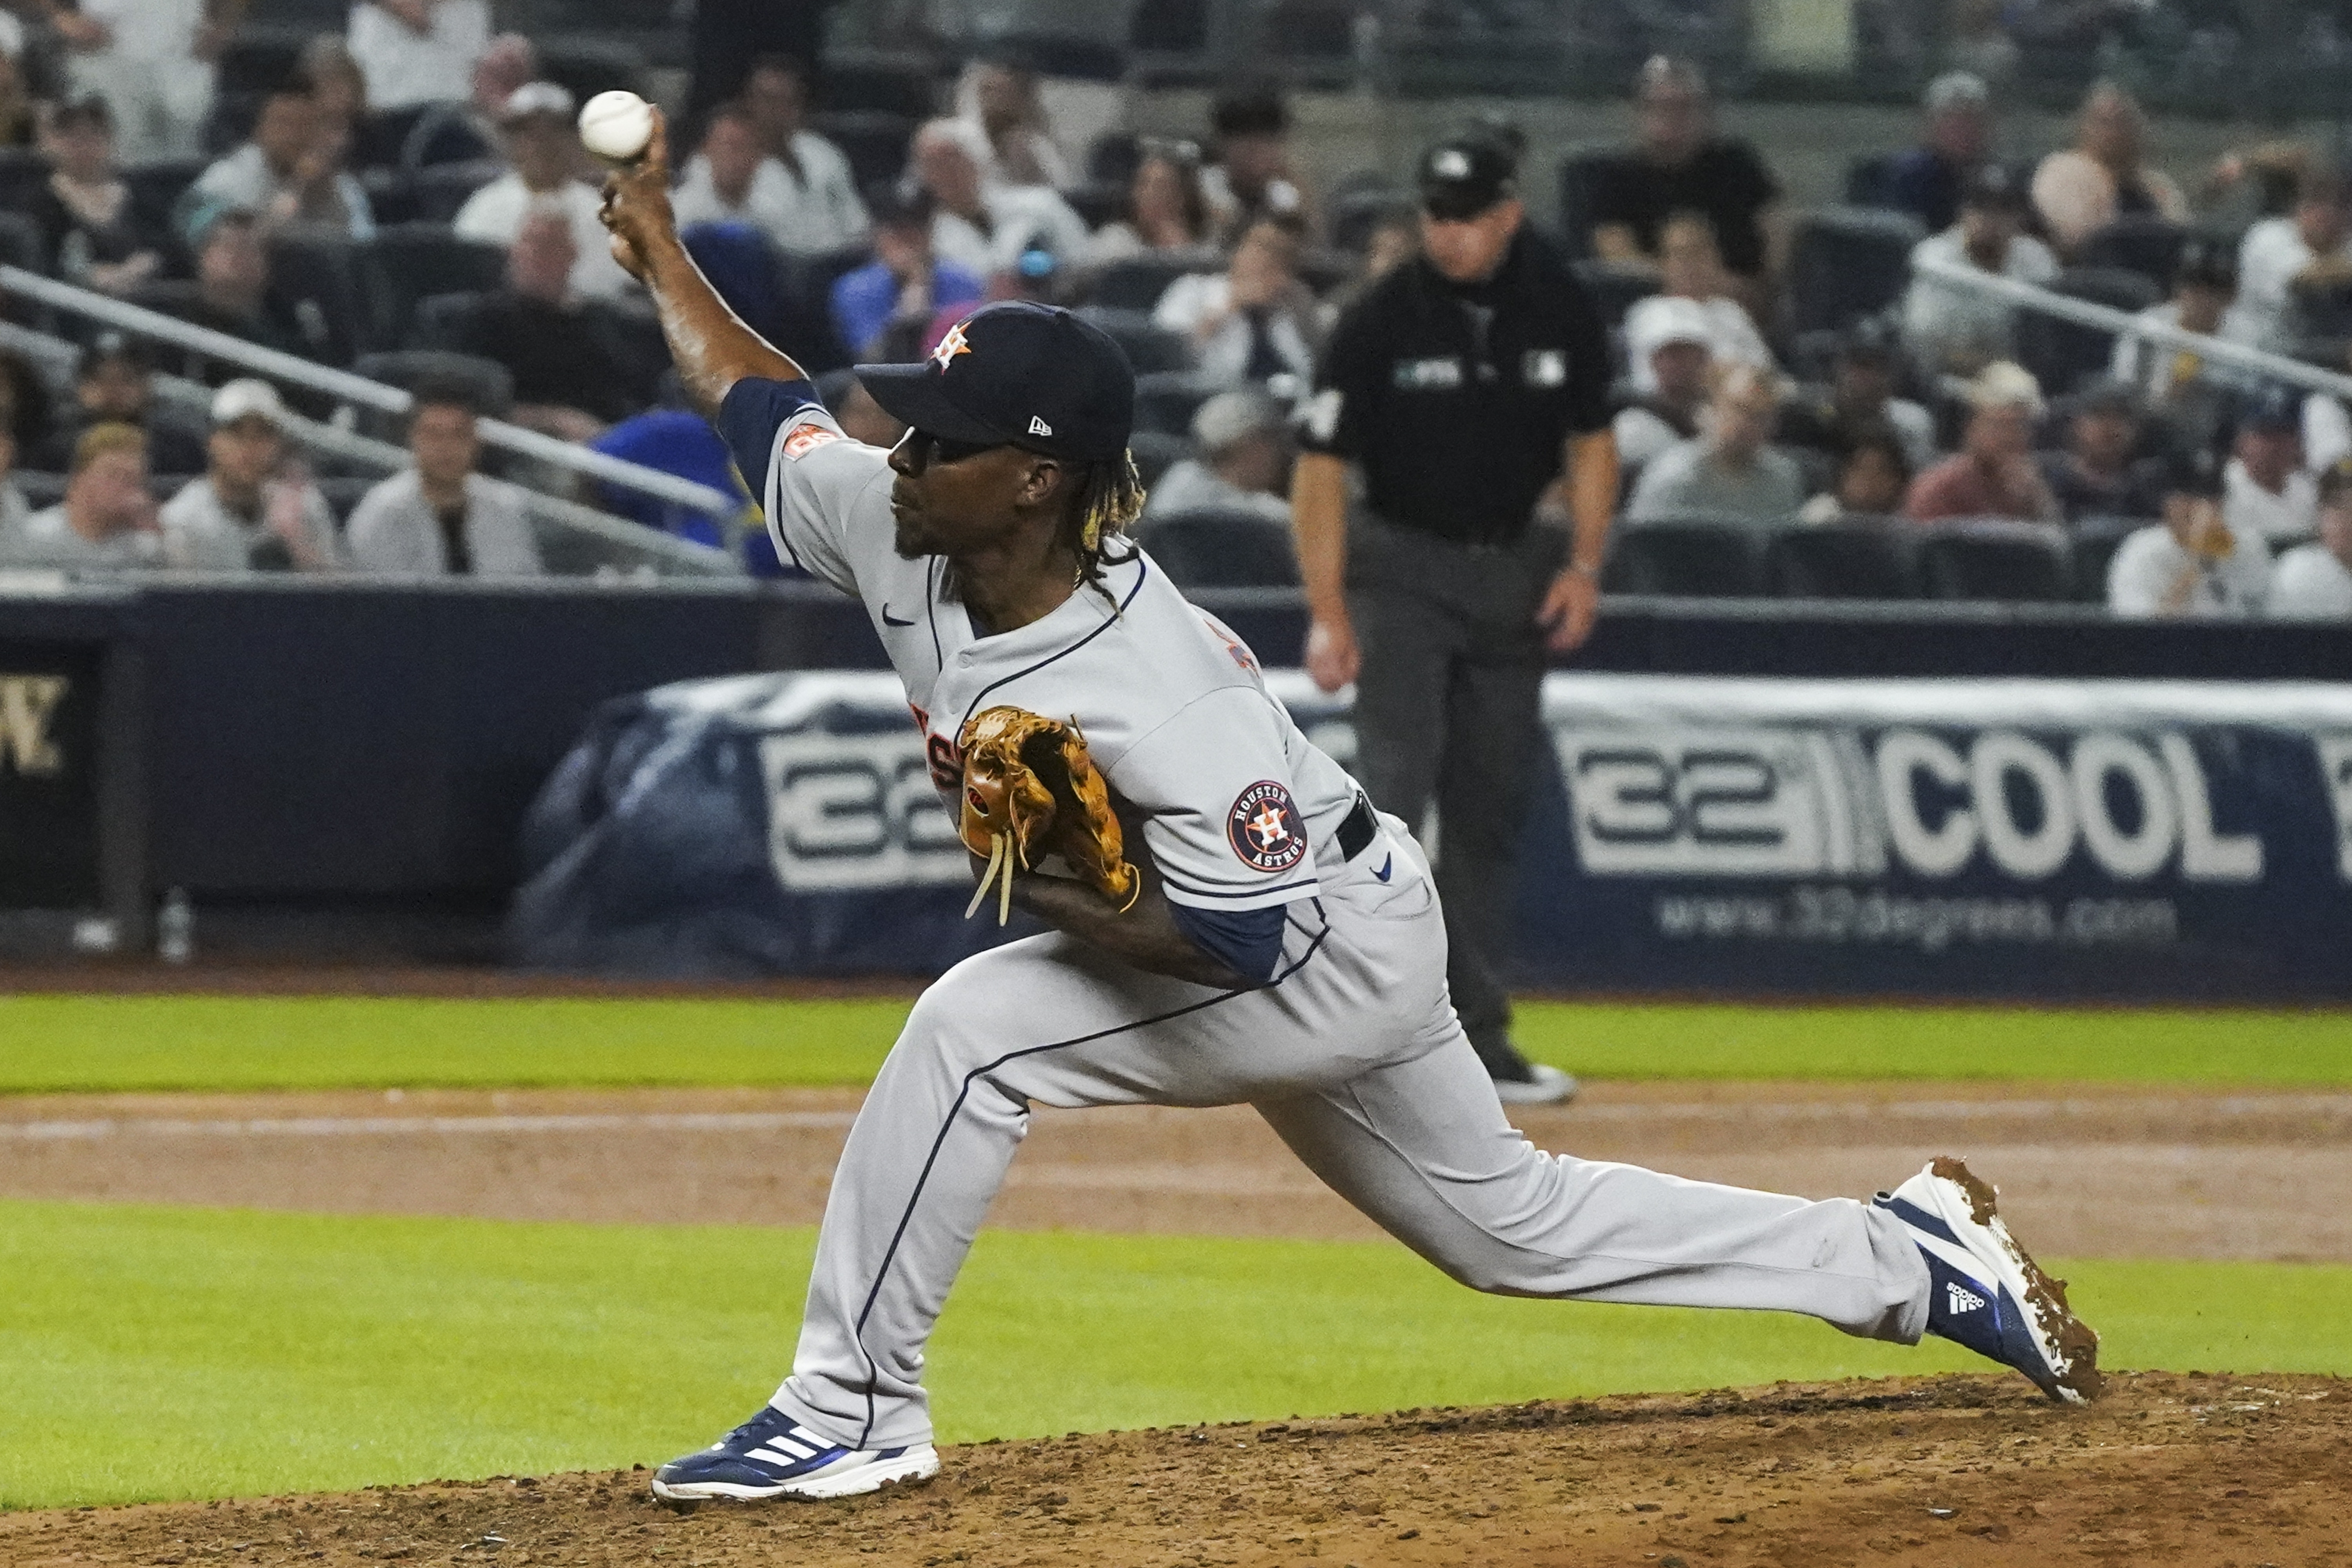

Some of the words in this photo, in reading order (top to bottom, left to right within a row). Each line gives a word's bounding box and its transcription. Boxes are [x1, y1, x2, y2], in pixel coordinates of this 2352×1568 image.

[1234, 786, 1288, 821] HOUSTON
[1574, 743, 1789, 849] 32
[1877, 728, 2265, 883] COOL
[1252, 836, 1303, 866] ASTROS
[1656, 885, 2180, 953] www.32degrees.com
[1946, 1281, 1985, 1308] adidas
